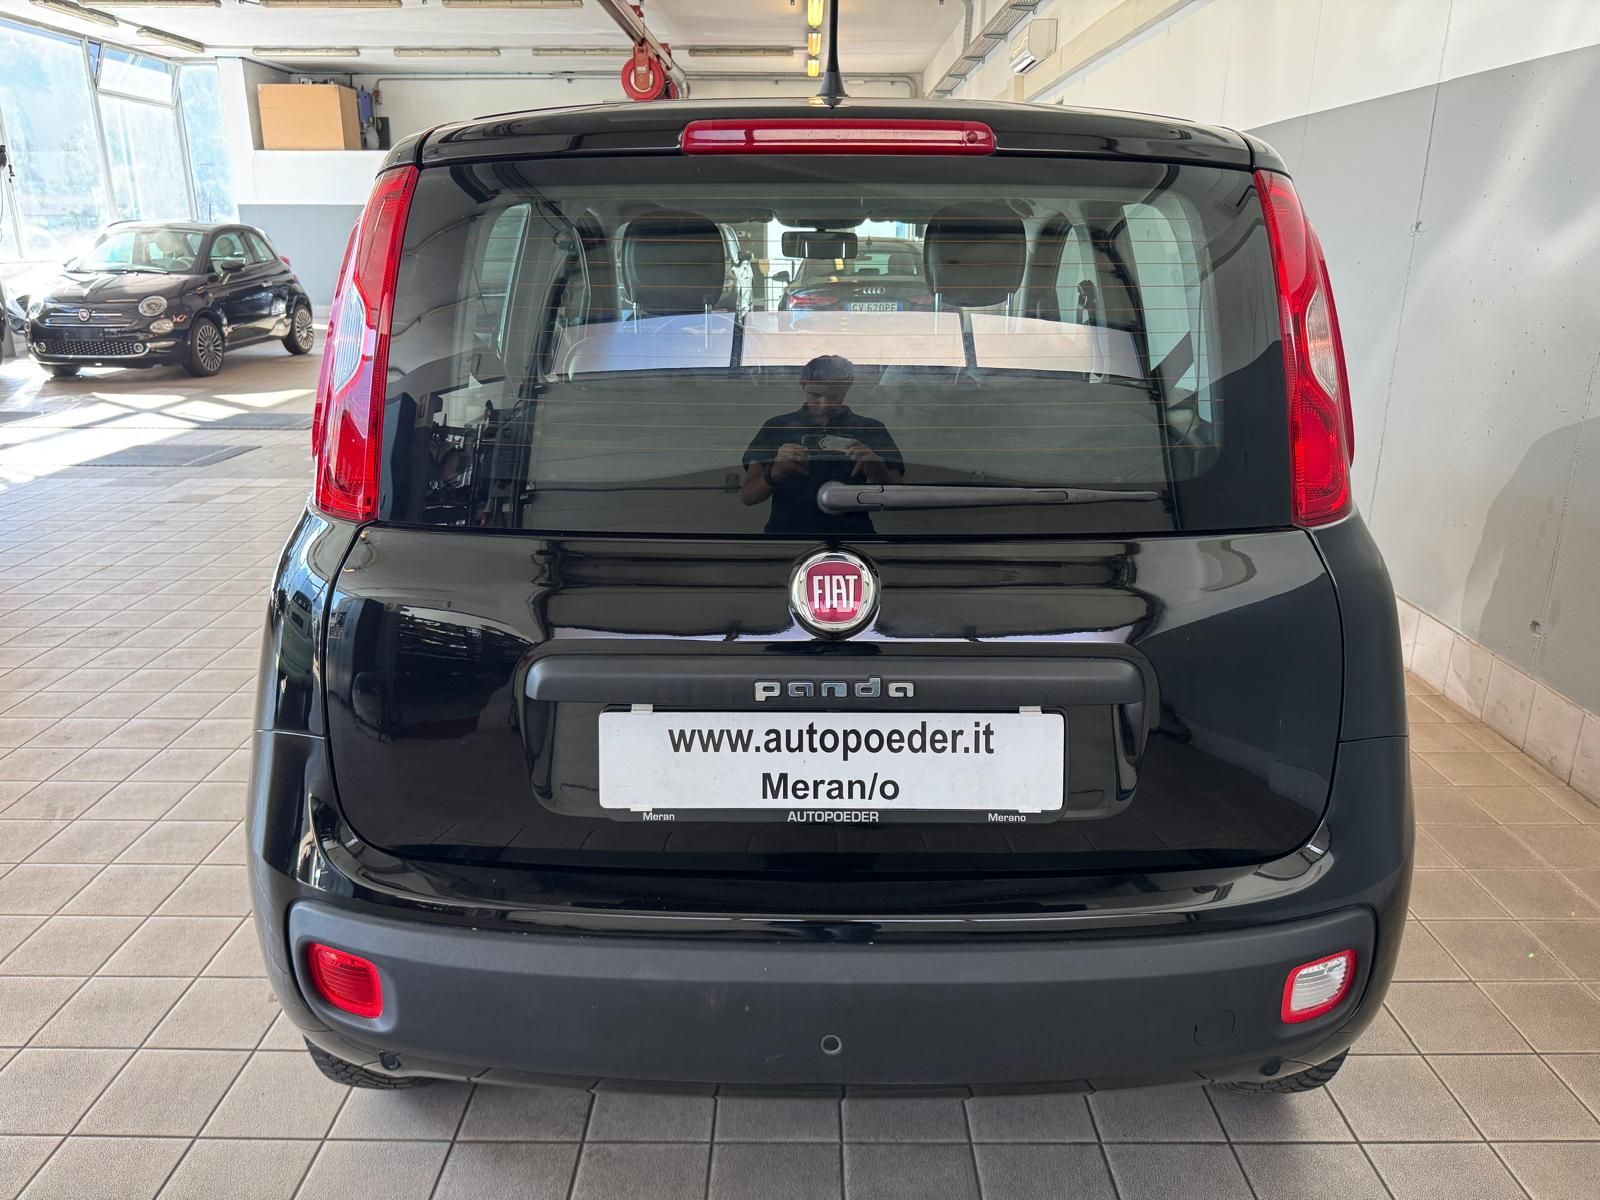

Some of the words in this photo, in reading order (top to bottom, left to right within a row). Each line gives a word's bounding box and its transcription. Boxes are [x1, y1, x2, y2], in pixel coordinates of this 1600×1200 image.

[812, 574, 858, 609] FIAT
[754, 676, 915, 702] panda
[668, 721, 995, 762] www.autopoeder.it
[762, 772, 900, 801] Meran/o
[642, 811, 676, 822] Meran
[787, 810, 880, 823] AUTOPOEDER
[987, 812, 1028, 823] Merano
